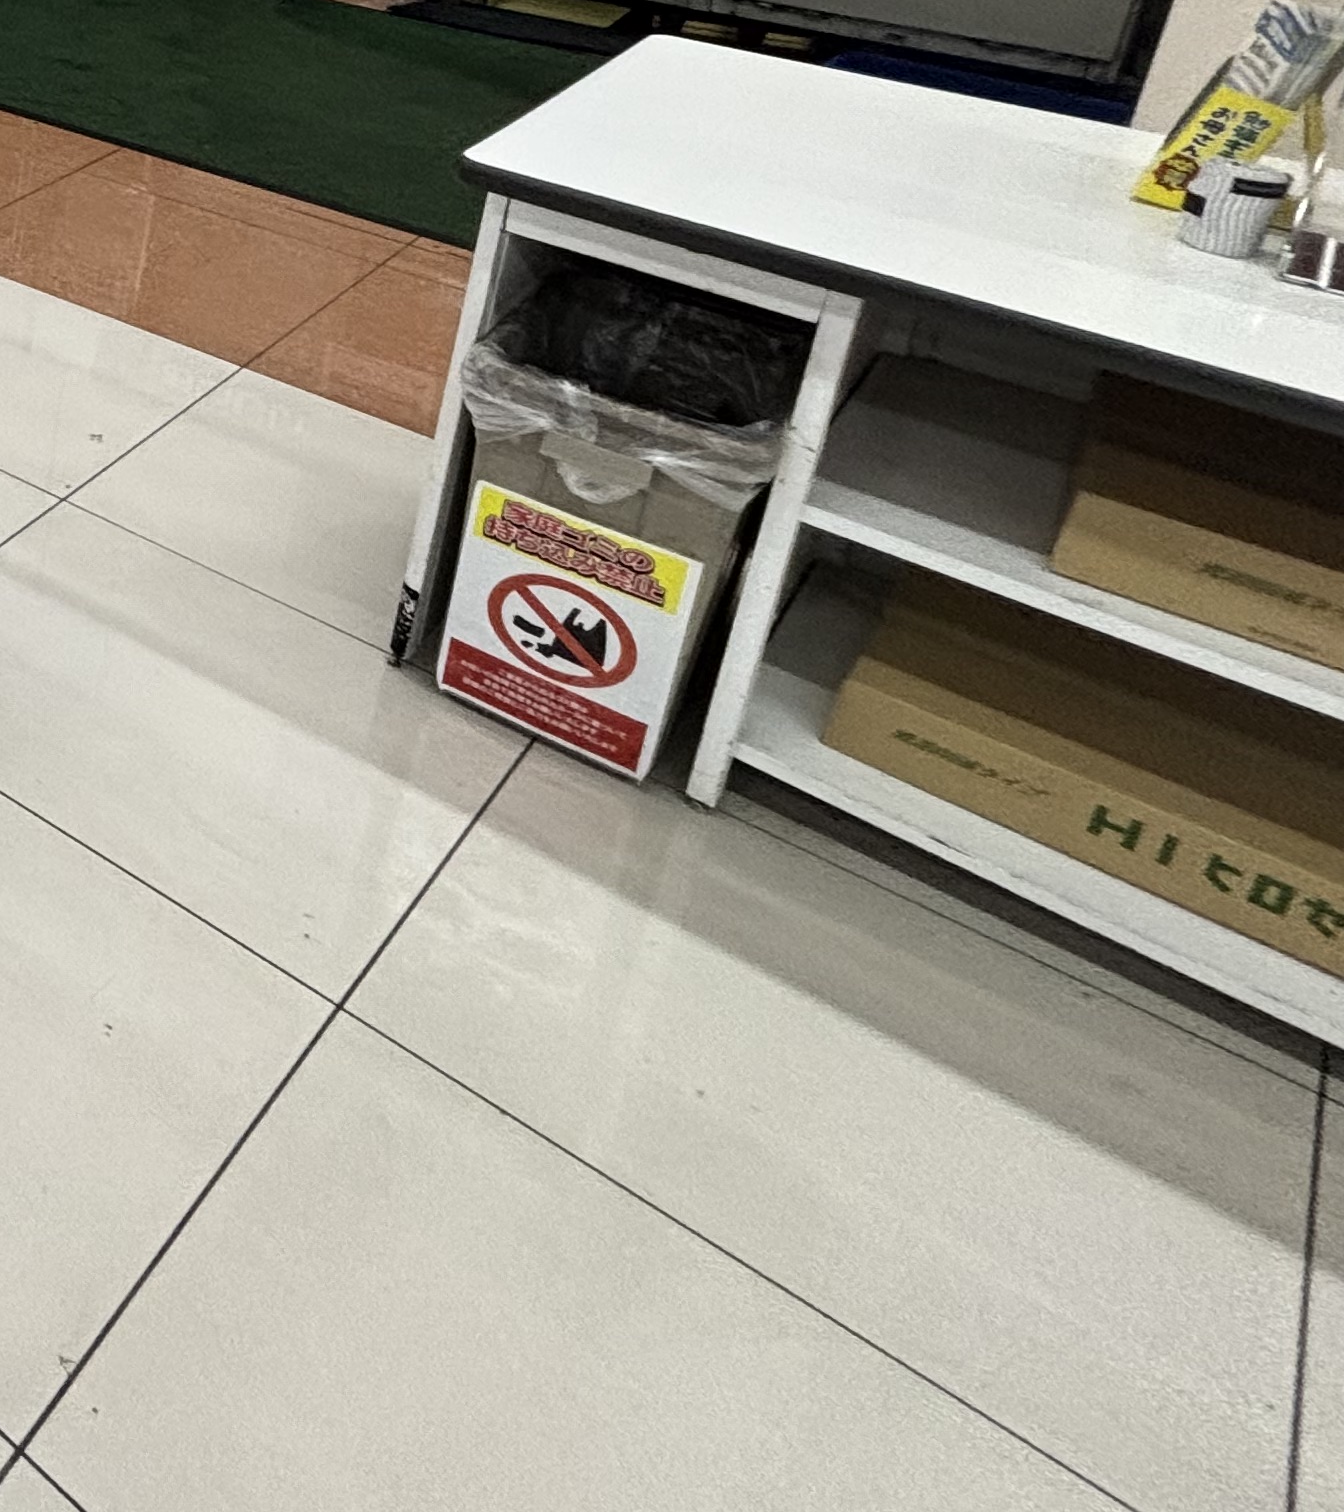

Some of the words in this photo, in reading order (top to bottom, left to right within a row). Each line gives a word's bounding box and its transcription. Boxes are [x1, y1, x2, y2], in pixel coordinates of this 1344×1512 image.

[483, 514, 667, 608] 持ち込み禁止
[501, 498, 655, 575] 家庭ゴミの
